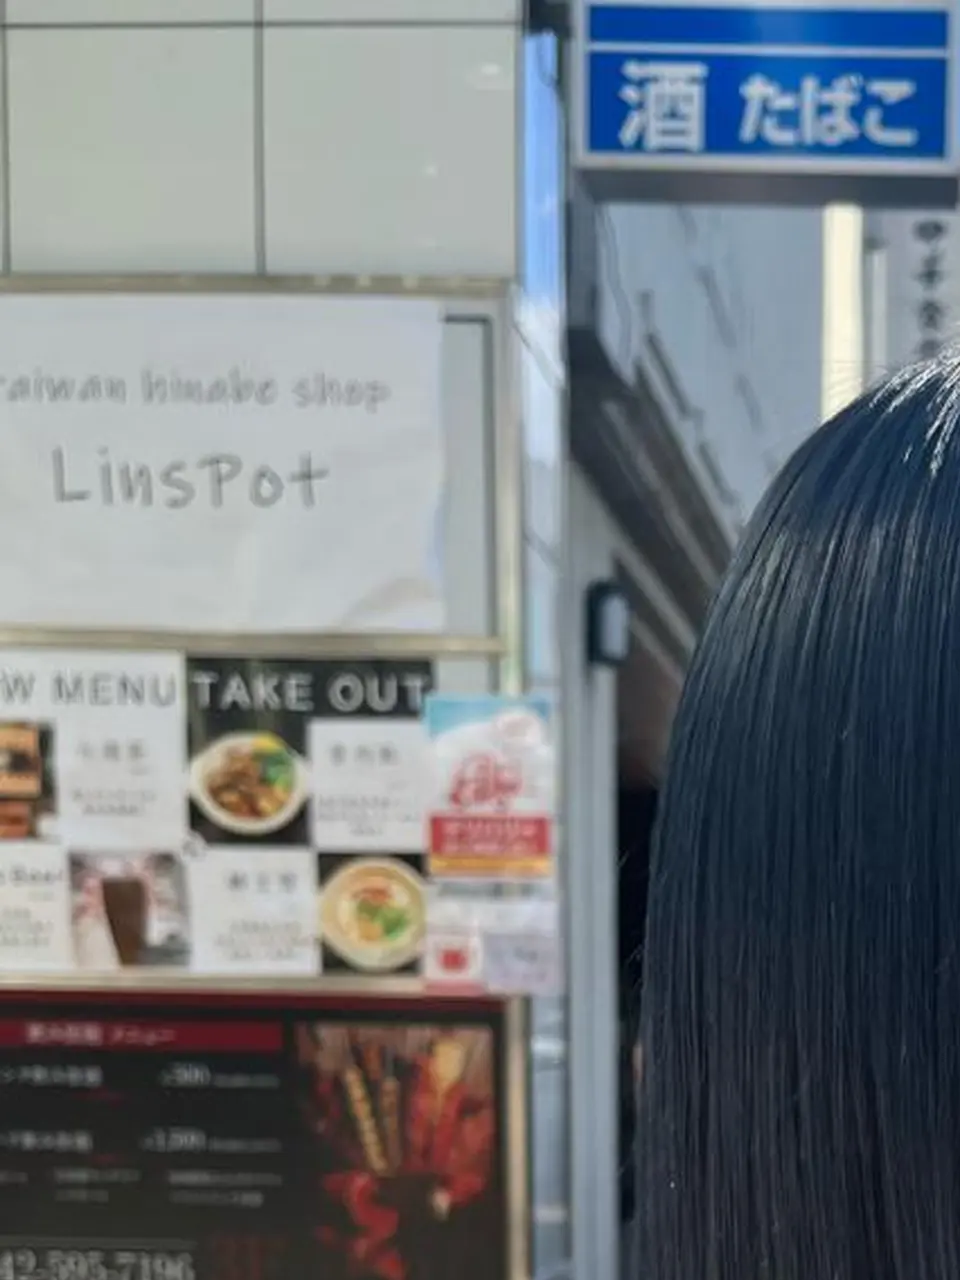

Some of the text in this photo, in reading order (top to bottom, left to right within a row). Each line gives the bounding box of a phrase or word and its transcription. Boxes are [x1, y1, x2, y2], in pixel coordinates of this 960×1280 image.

[618, 59, 918, 153] 酒 たばこ
[292, 370, 392, 414] shop
[53, 671, 177, 707] MENU
[191, 670, 428, 712] TAKE OUT
